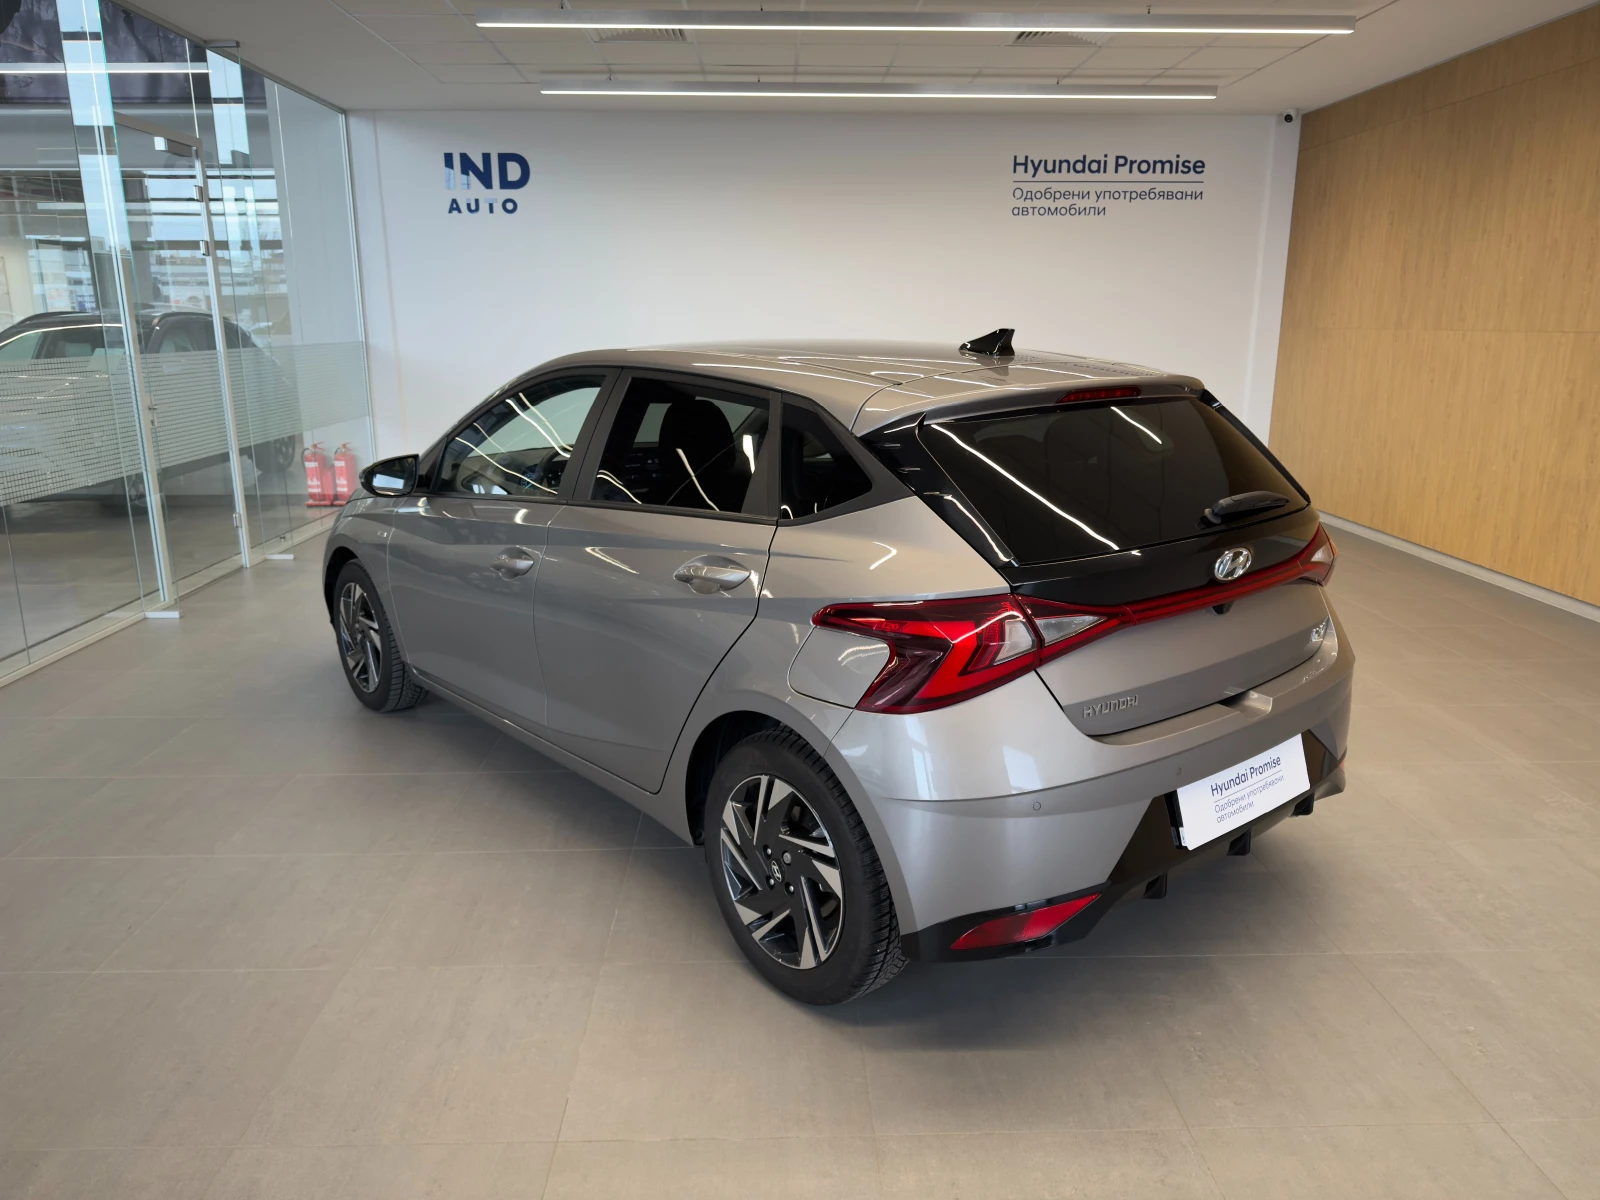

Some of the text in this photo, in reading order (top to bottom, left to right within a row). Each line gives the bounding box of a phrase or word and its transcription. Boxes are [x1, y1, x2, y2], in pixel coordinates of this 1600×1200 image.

[443, 152, 531, 190] IND
[1012, 154, 1206, 178] Hyundai Promise
[448, 198, 518, 215] AUTO
[1012, 187, 1204, 203] Одобрени употребявани
[1011, 203, 1107, 216] автомобили
[1082, 695, 1138, 719] HYUNDAI
[1210, 755, 1282, 797] Hyundai Promise
[1214, 774, 1285, 814] Одобрени употребявани
[1216, 801, 1255, 823] автомобили
